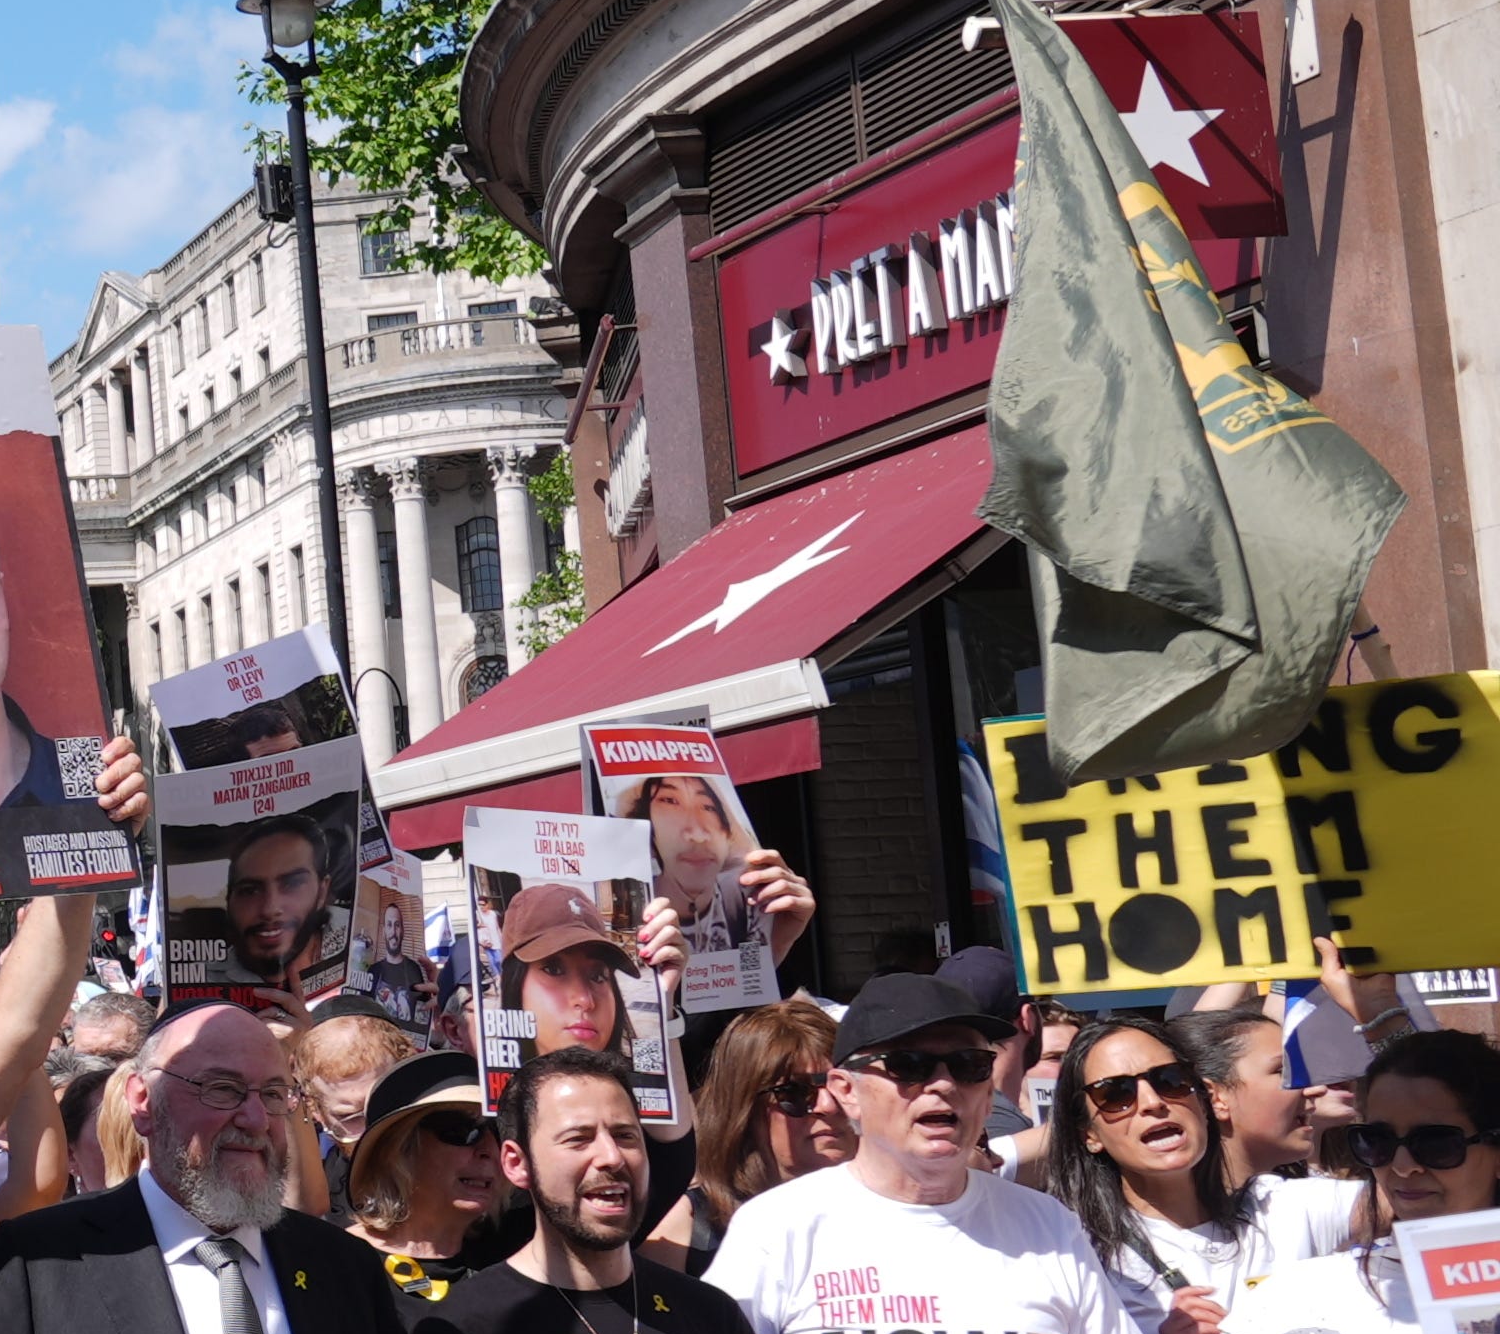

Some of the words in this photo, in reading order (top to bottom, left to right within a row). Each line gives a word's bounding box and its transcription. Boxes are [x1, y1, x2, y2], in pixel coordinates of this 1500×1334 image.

[810, 253, 894, 375] PRET
[909, 235, 941, 338] A
[341, 398, 568, 445] SUID-AFRIK
[227, 677, 242, 692] OR
[242, 668, 264, 688] LEVY
[242, 687, 263, 704] (33)
[599, 740, 716, 764] KIDNAPPED
[1004, 681, 1463, 805] BNG
[213, 786, 250, 806] MATAN
[253, 772, 311, 797] ZANGAUKER
[253, 796, 275, 815] (24)
[23, 834, 67, 854] HOSTAGES
[69, 832, 86, 851] AND
[88, 828, 128, 850] MISSING
[534, 839, 554, 856] LIRI
[555, 840, 585, 857] ALBAG
[1021, 790, 1371, 896] THEM
[26, 849, 86, 880] FAMILIES
[88, 844, 132, 875] FORUM
[542, 857, 560, 874] (19)
[1026, 878, 1379, 985] HOME
[170, 963, 207, 984] HIM
[685, 965, 710, 979] Bring
[712, 963, 736, 974] Them
[685, 979, 711, 992] Home
[712, 976, 738, 990] NOW.
[483, 1008, 537, 1040] BRING
[487, 1038, 522, 1069] HER
[813, 1265, 881, 1300] BRING
[819, 1297, 879, 1328] THEM
[882, 1295, 942, 1324] HOME
